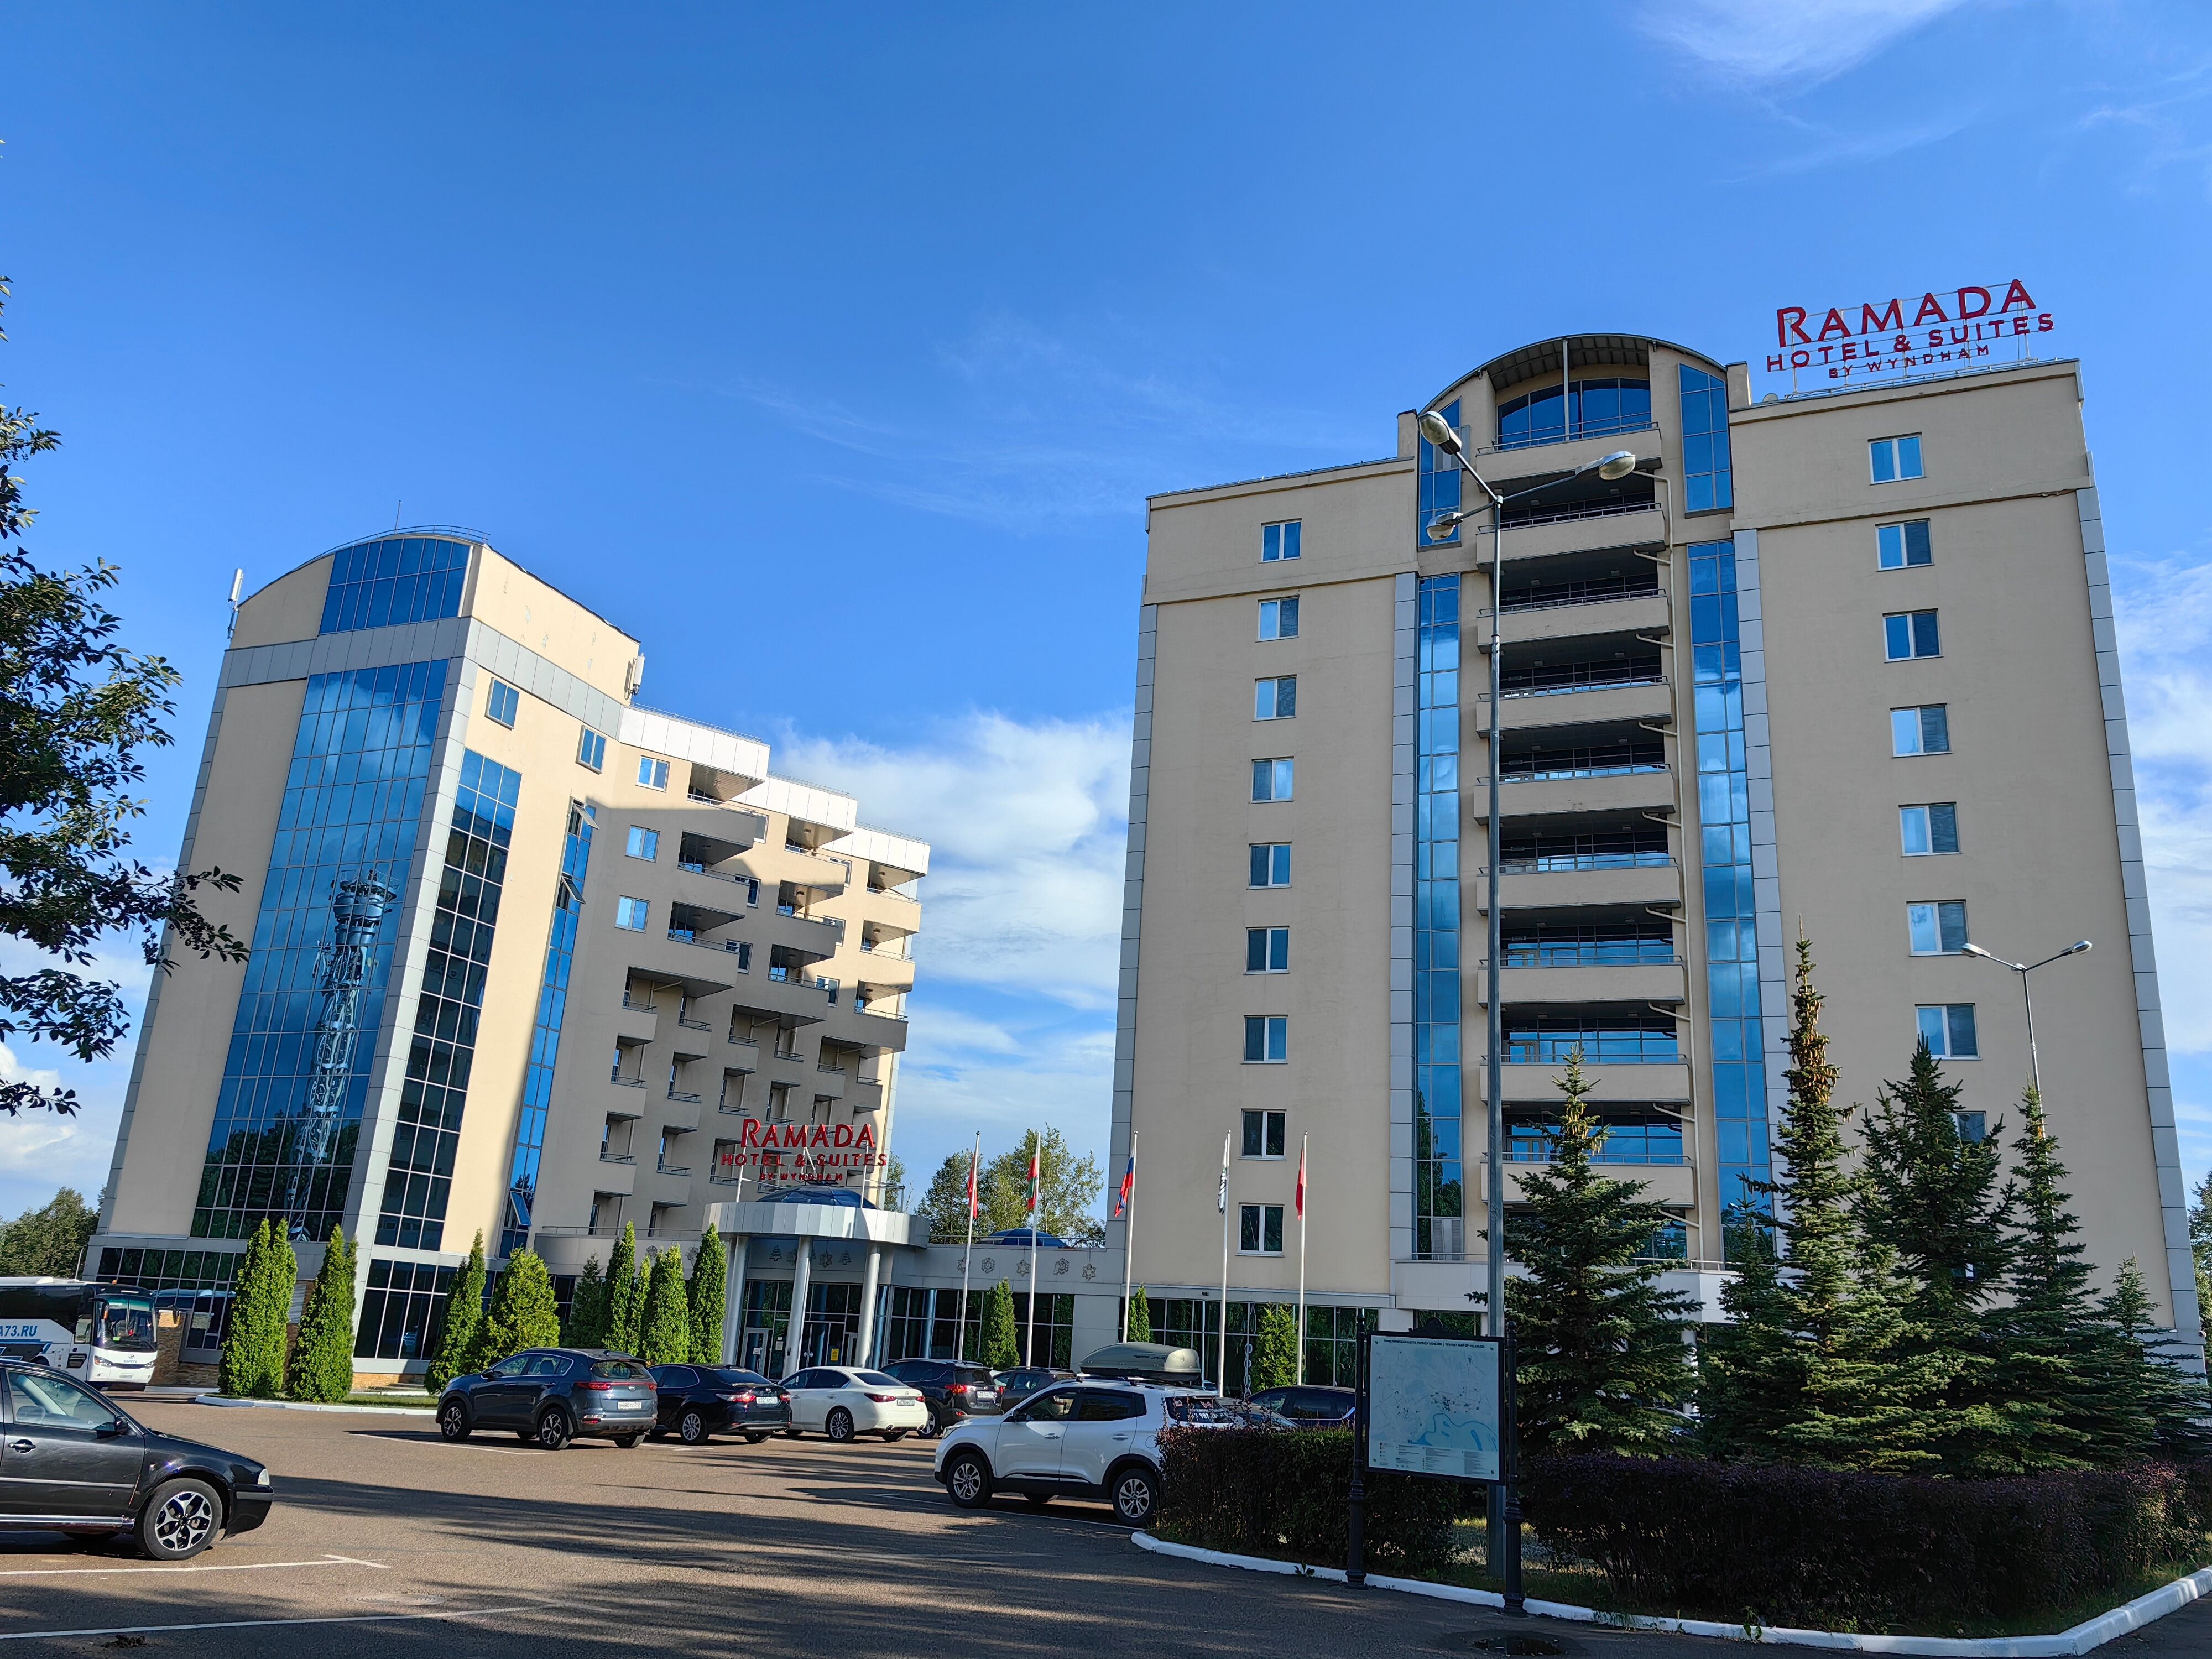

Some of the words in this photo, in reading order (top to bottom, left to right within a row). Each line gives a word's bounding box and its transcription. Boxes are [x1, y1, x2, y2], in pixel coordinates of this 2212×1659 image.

[1777, 279, 2036, 347] RAMADA
[1767, 340, 1879, 372] HOTEL
[1893, 335, 1911, 352] &
[1929, 313, 2054, 348] SUITES
[1829, 366, 1853, 379] BY
[1867, 345, 1989, 373] WYNDHAM
[740, 1118, 876, 1149] RAMADA
[721, 1153, 784, 1167] HOTEL
[795, 1154, 806, 1168] &
[817, 1153, 888, 1167] SUITES
[759, 1172, 774, 1181] BY
[780, 1172, 843, 1182] WYNDHAM
